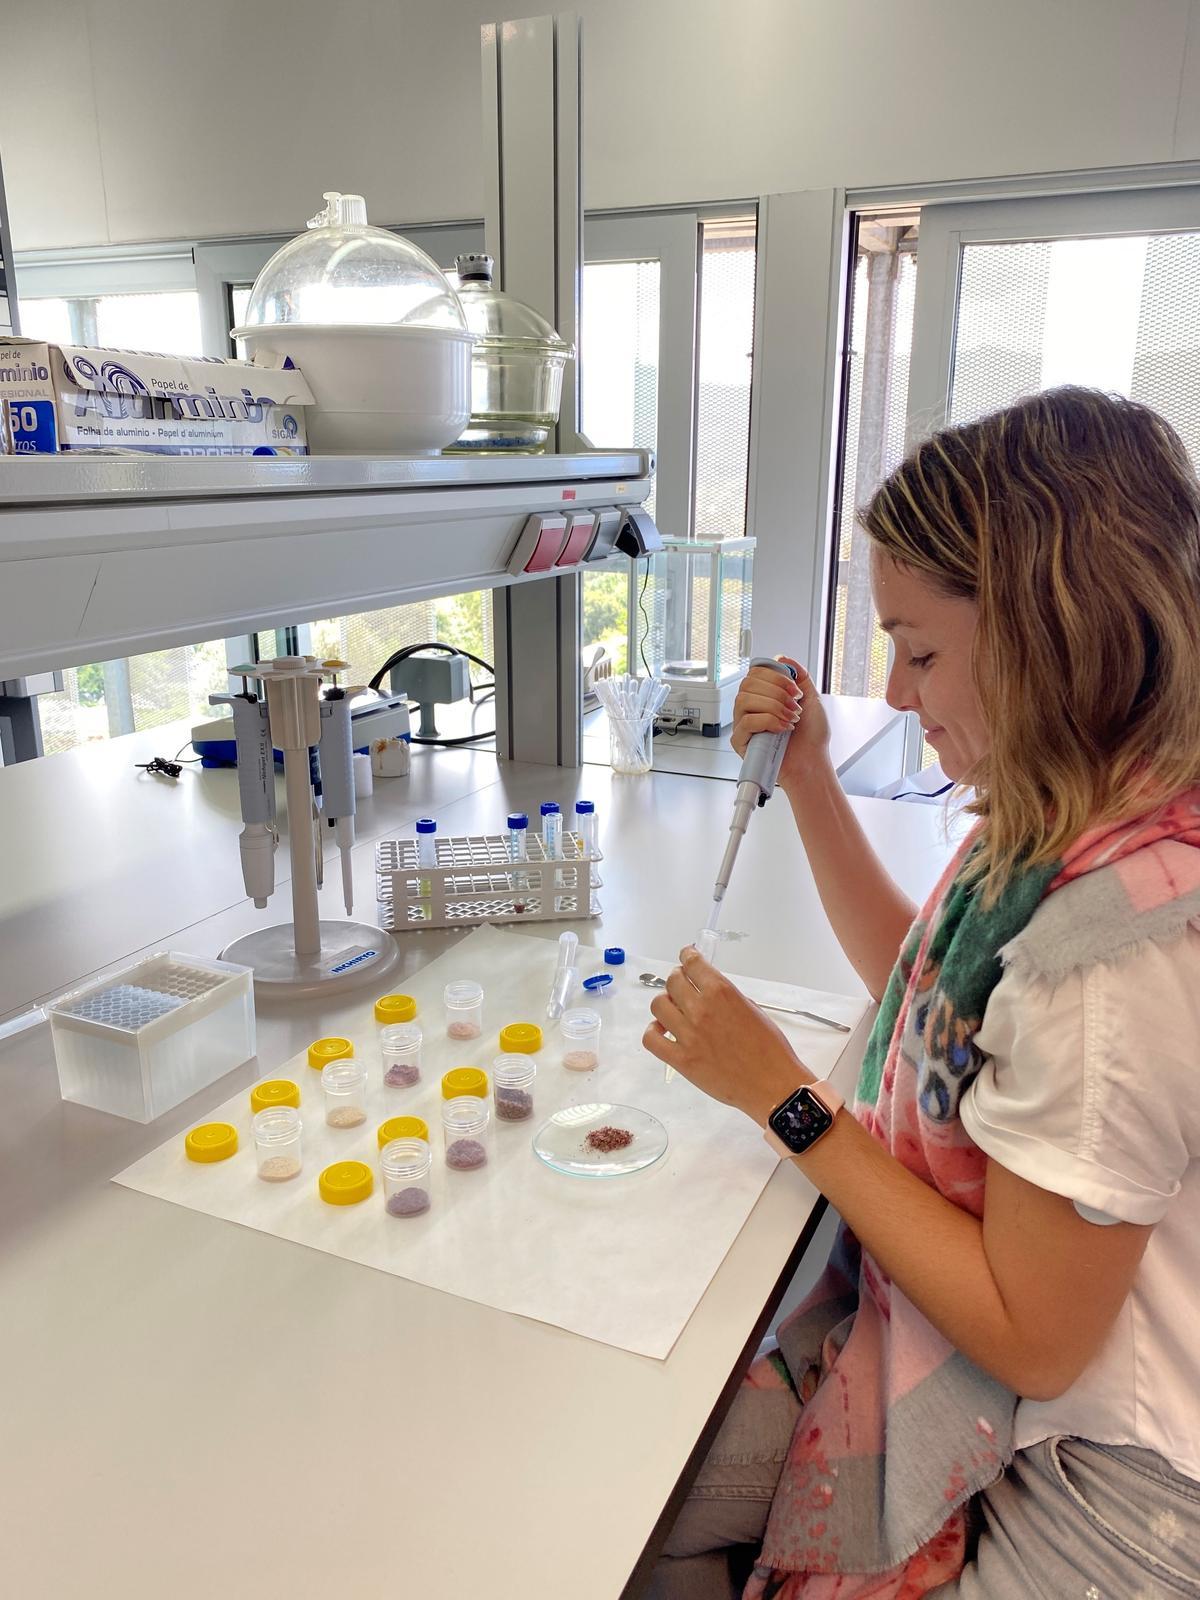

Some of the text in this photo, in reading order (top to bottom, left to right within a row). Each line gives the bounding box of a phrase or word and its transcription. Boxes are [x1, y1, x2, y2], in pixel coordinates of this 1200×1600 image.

[13, 351, 21, 359] de
[0, 362, 49, 381] minio
[151, 378, 190, 391] Papel de
[77, 426, 101, 436] Folha
[103, 427, 114, 436] de
[158, 428, 179, 439] Papel
[272, 429, 297, 440] SIGAL
